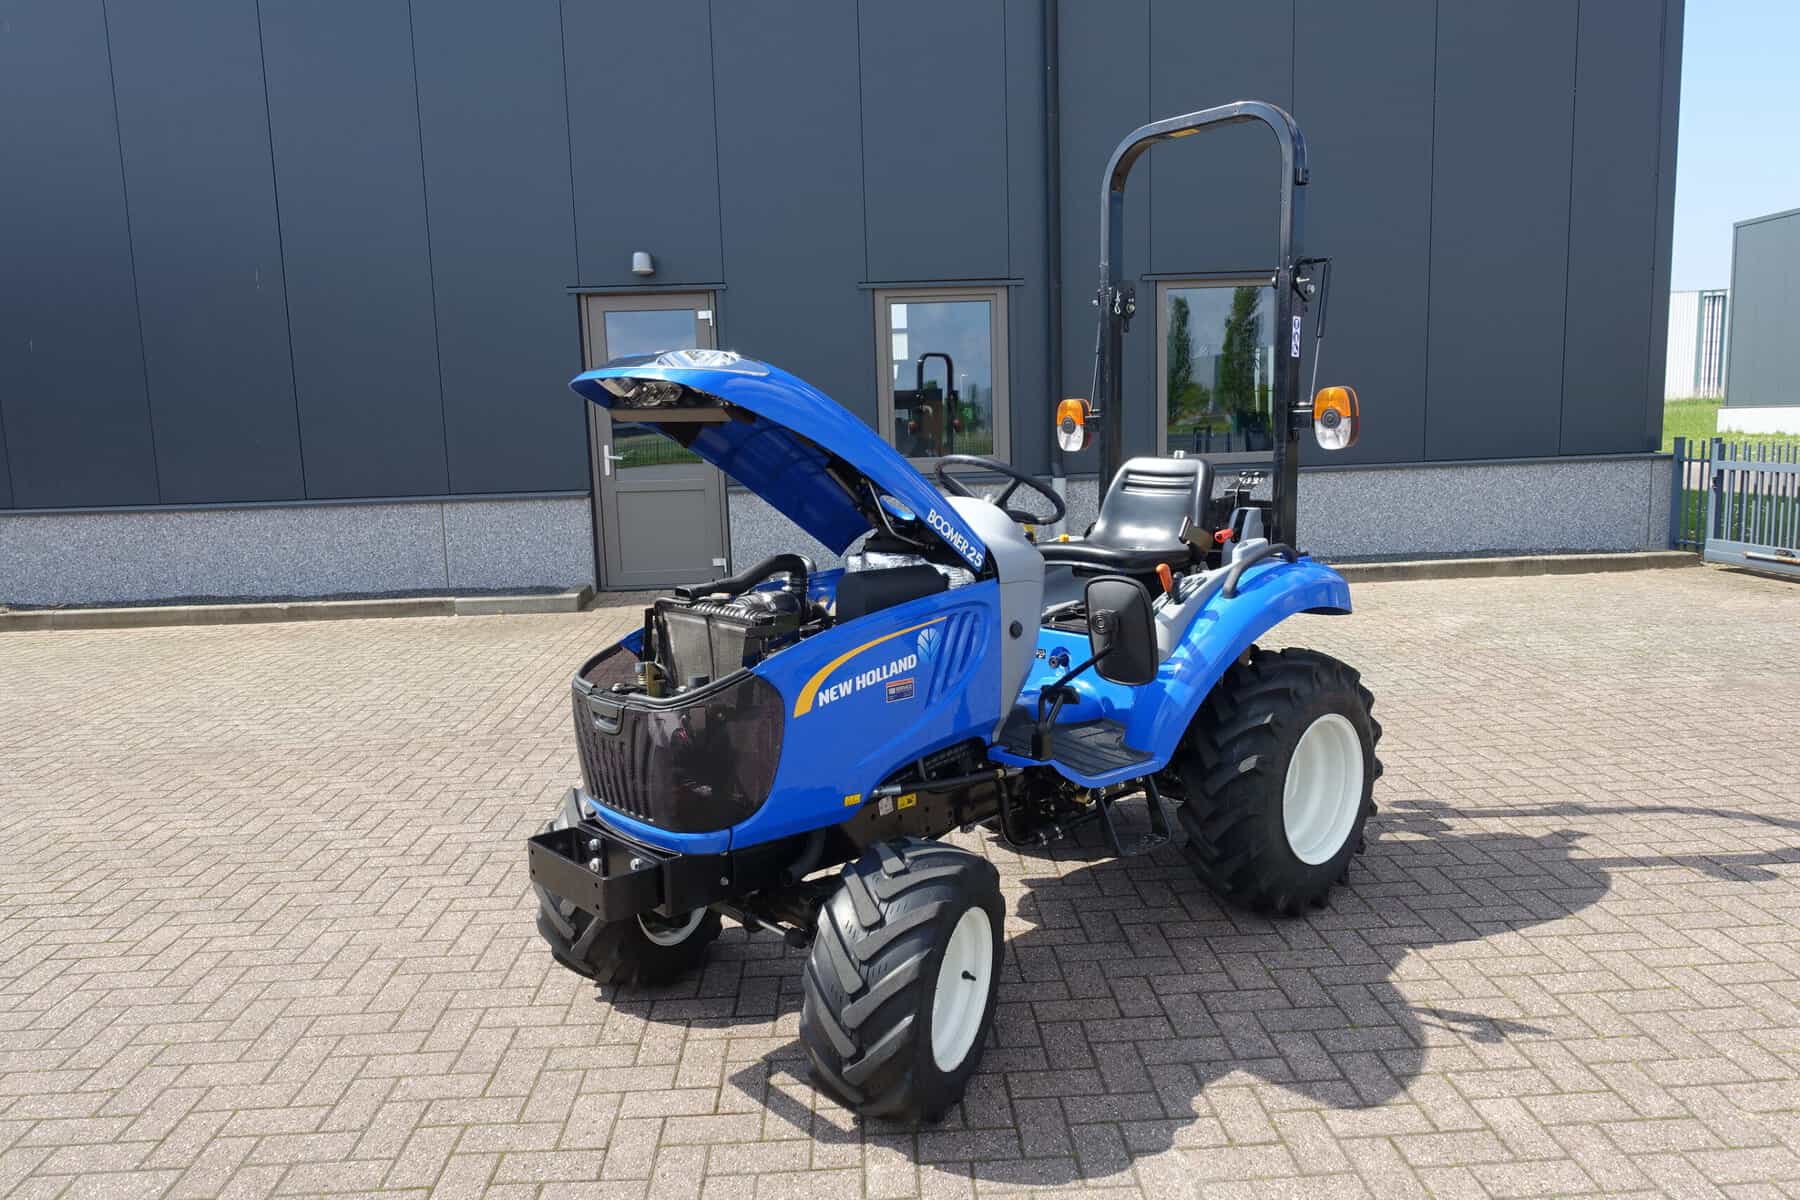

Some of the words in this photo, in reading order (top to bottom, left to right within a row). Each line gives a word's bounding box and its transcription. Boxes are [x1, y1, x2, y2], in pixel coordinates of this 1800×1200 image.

[927, 508, 968, 553] BOOMER
[966, 547, 983, 567] 25
[818, 679, 853, 707] NEW
[856, 654, 917, 691] HOLLAND
